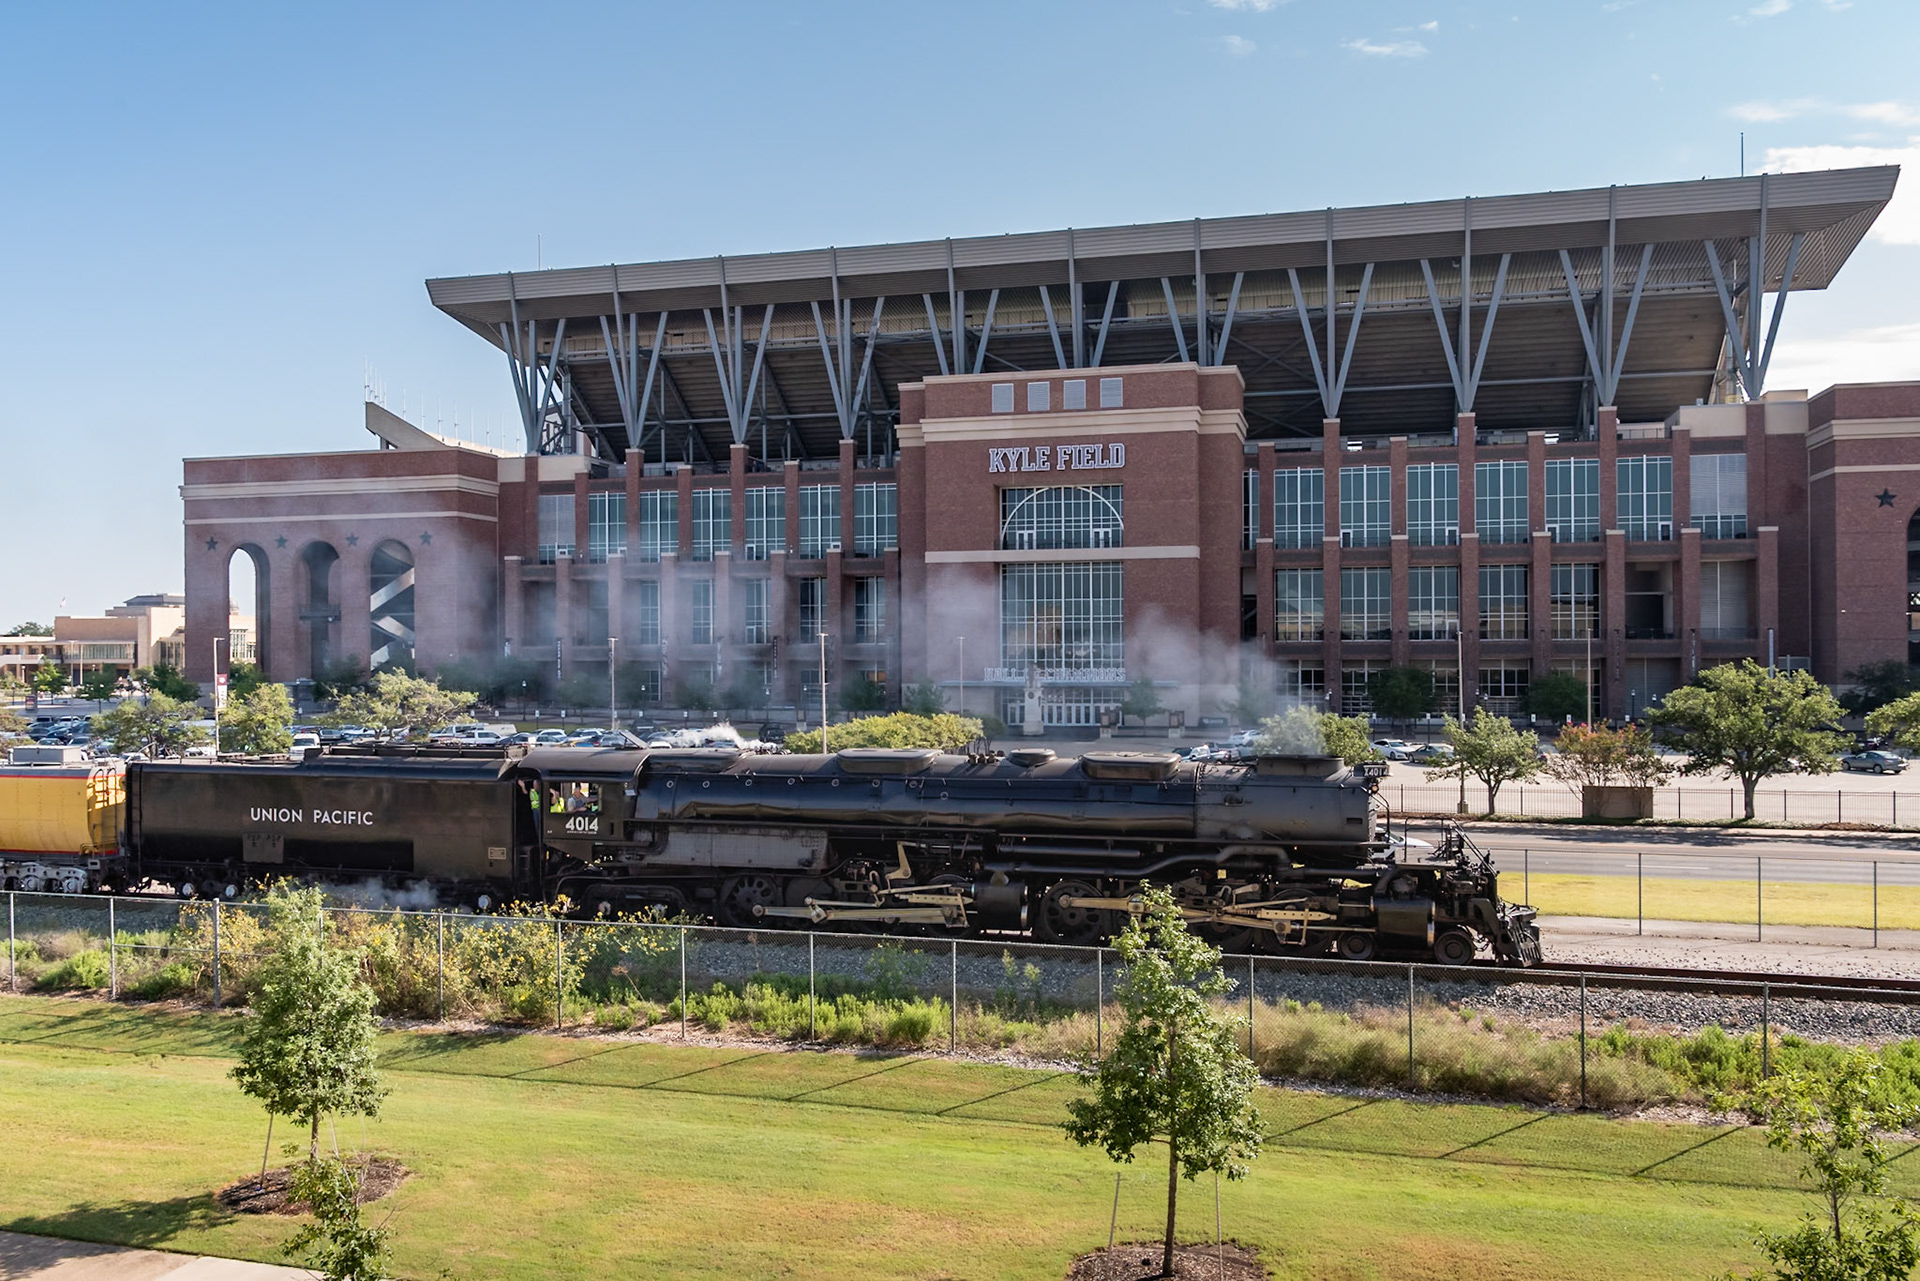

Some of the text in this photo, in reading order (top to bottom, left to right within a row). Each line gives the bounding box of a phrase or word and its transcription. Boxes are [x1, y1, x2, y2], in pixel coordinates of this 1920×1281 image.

[989, 443, 1125, 472] KYLE FIELD
[1364, 768, 1388, 776] X4014
[250, 807, 373, 825] UNION PACIFIC
[565, 816, 598, 831] 4014
